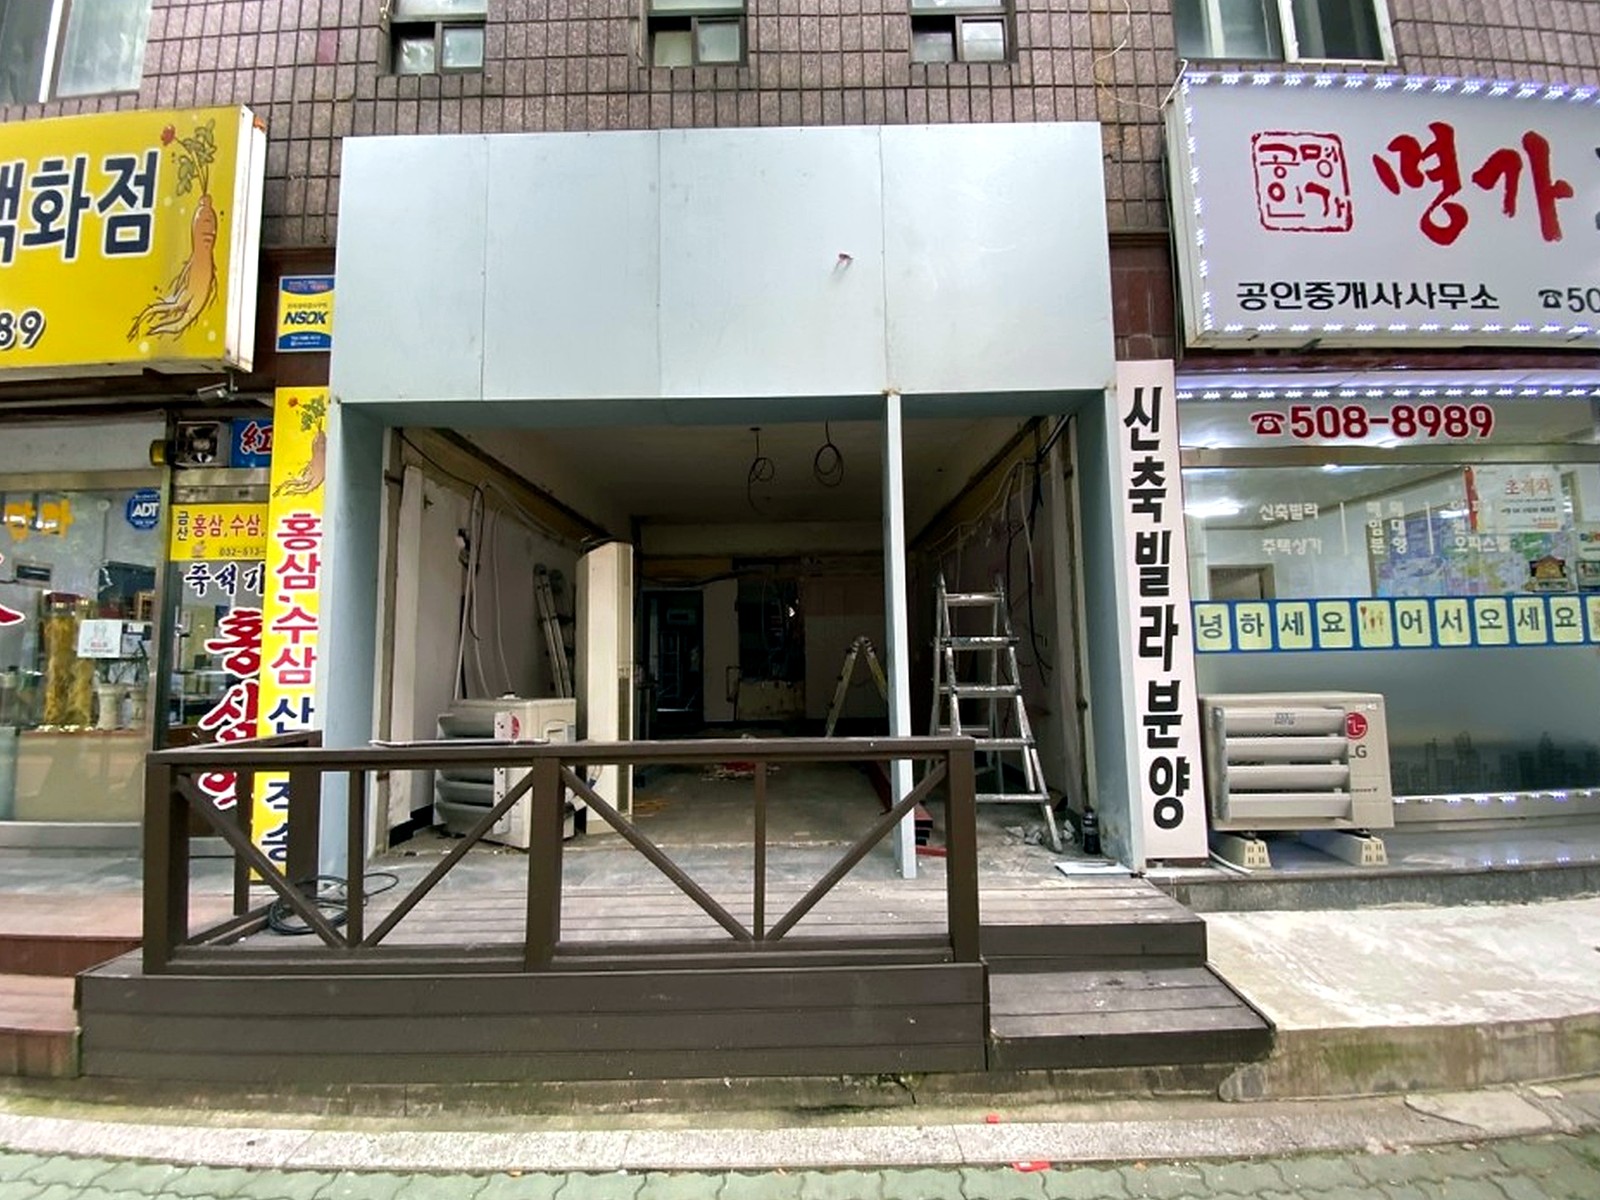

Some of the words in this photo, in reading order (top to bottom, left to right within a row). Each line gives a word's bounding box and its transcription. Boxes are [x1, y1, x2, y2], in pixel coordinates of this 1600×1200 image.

[1372, 121, 1573, 246] 명가
[1236, 281, 1501, 310] 공인중개사사무소
[284, 311, 328, 325] NSOK
[1291, 405, 1493, 438] 508-8989
[132, 502, 160, 517] ADT
[1400, 607, 1577, 633] 어서오세요
